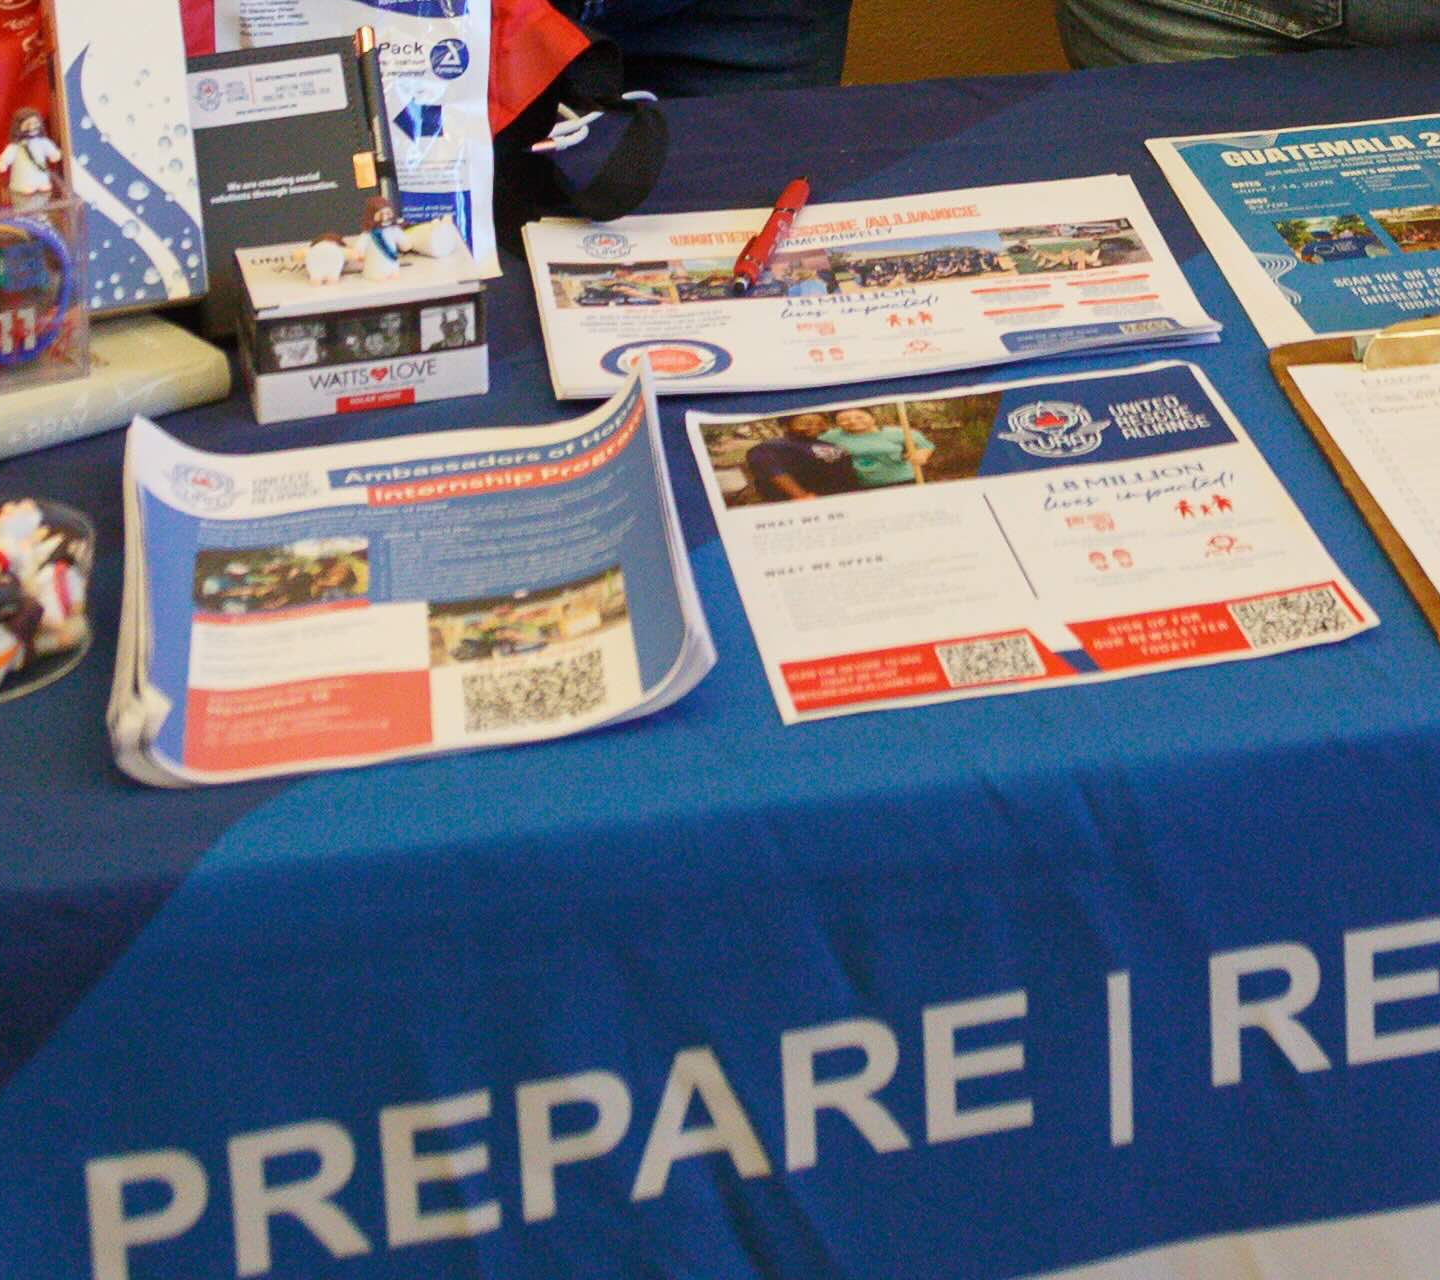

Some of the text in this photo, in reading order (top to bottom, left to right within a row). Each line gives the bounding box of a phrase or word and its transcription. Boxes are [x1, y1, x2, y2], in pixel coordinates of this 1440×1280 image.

[378, 42, 424, 55] Pack
[1220, 134, 1415, 168] GUATEMALA
[309, 357, 438, 391] WATTS LOVE
[1109, 393, 1180, 418] UNITED
[344, 451, 541, 485] Ambassadors
[548, 442, 575, 459] of
[1082, 462, 1204, 490] MILLION
[373, 471, 533, 505] Internship
[84, 988, 1034, 1280] PREPARE
